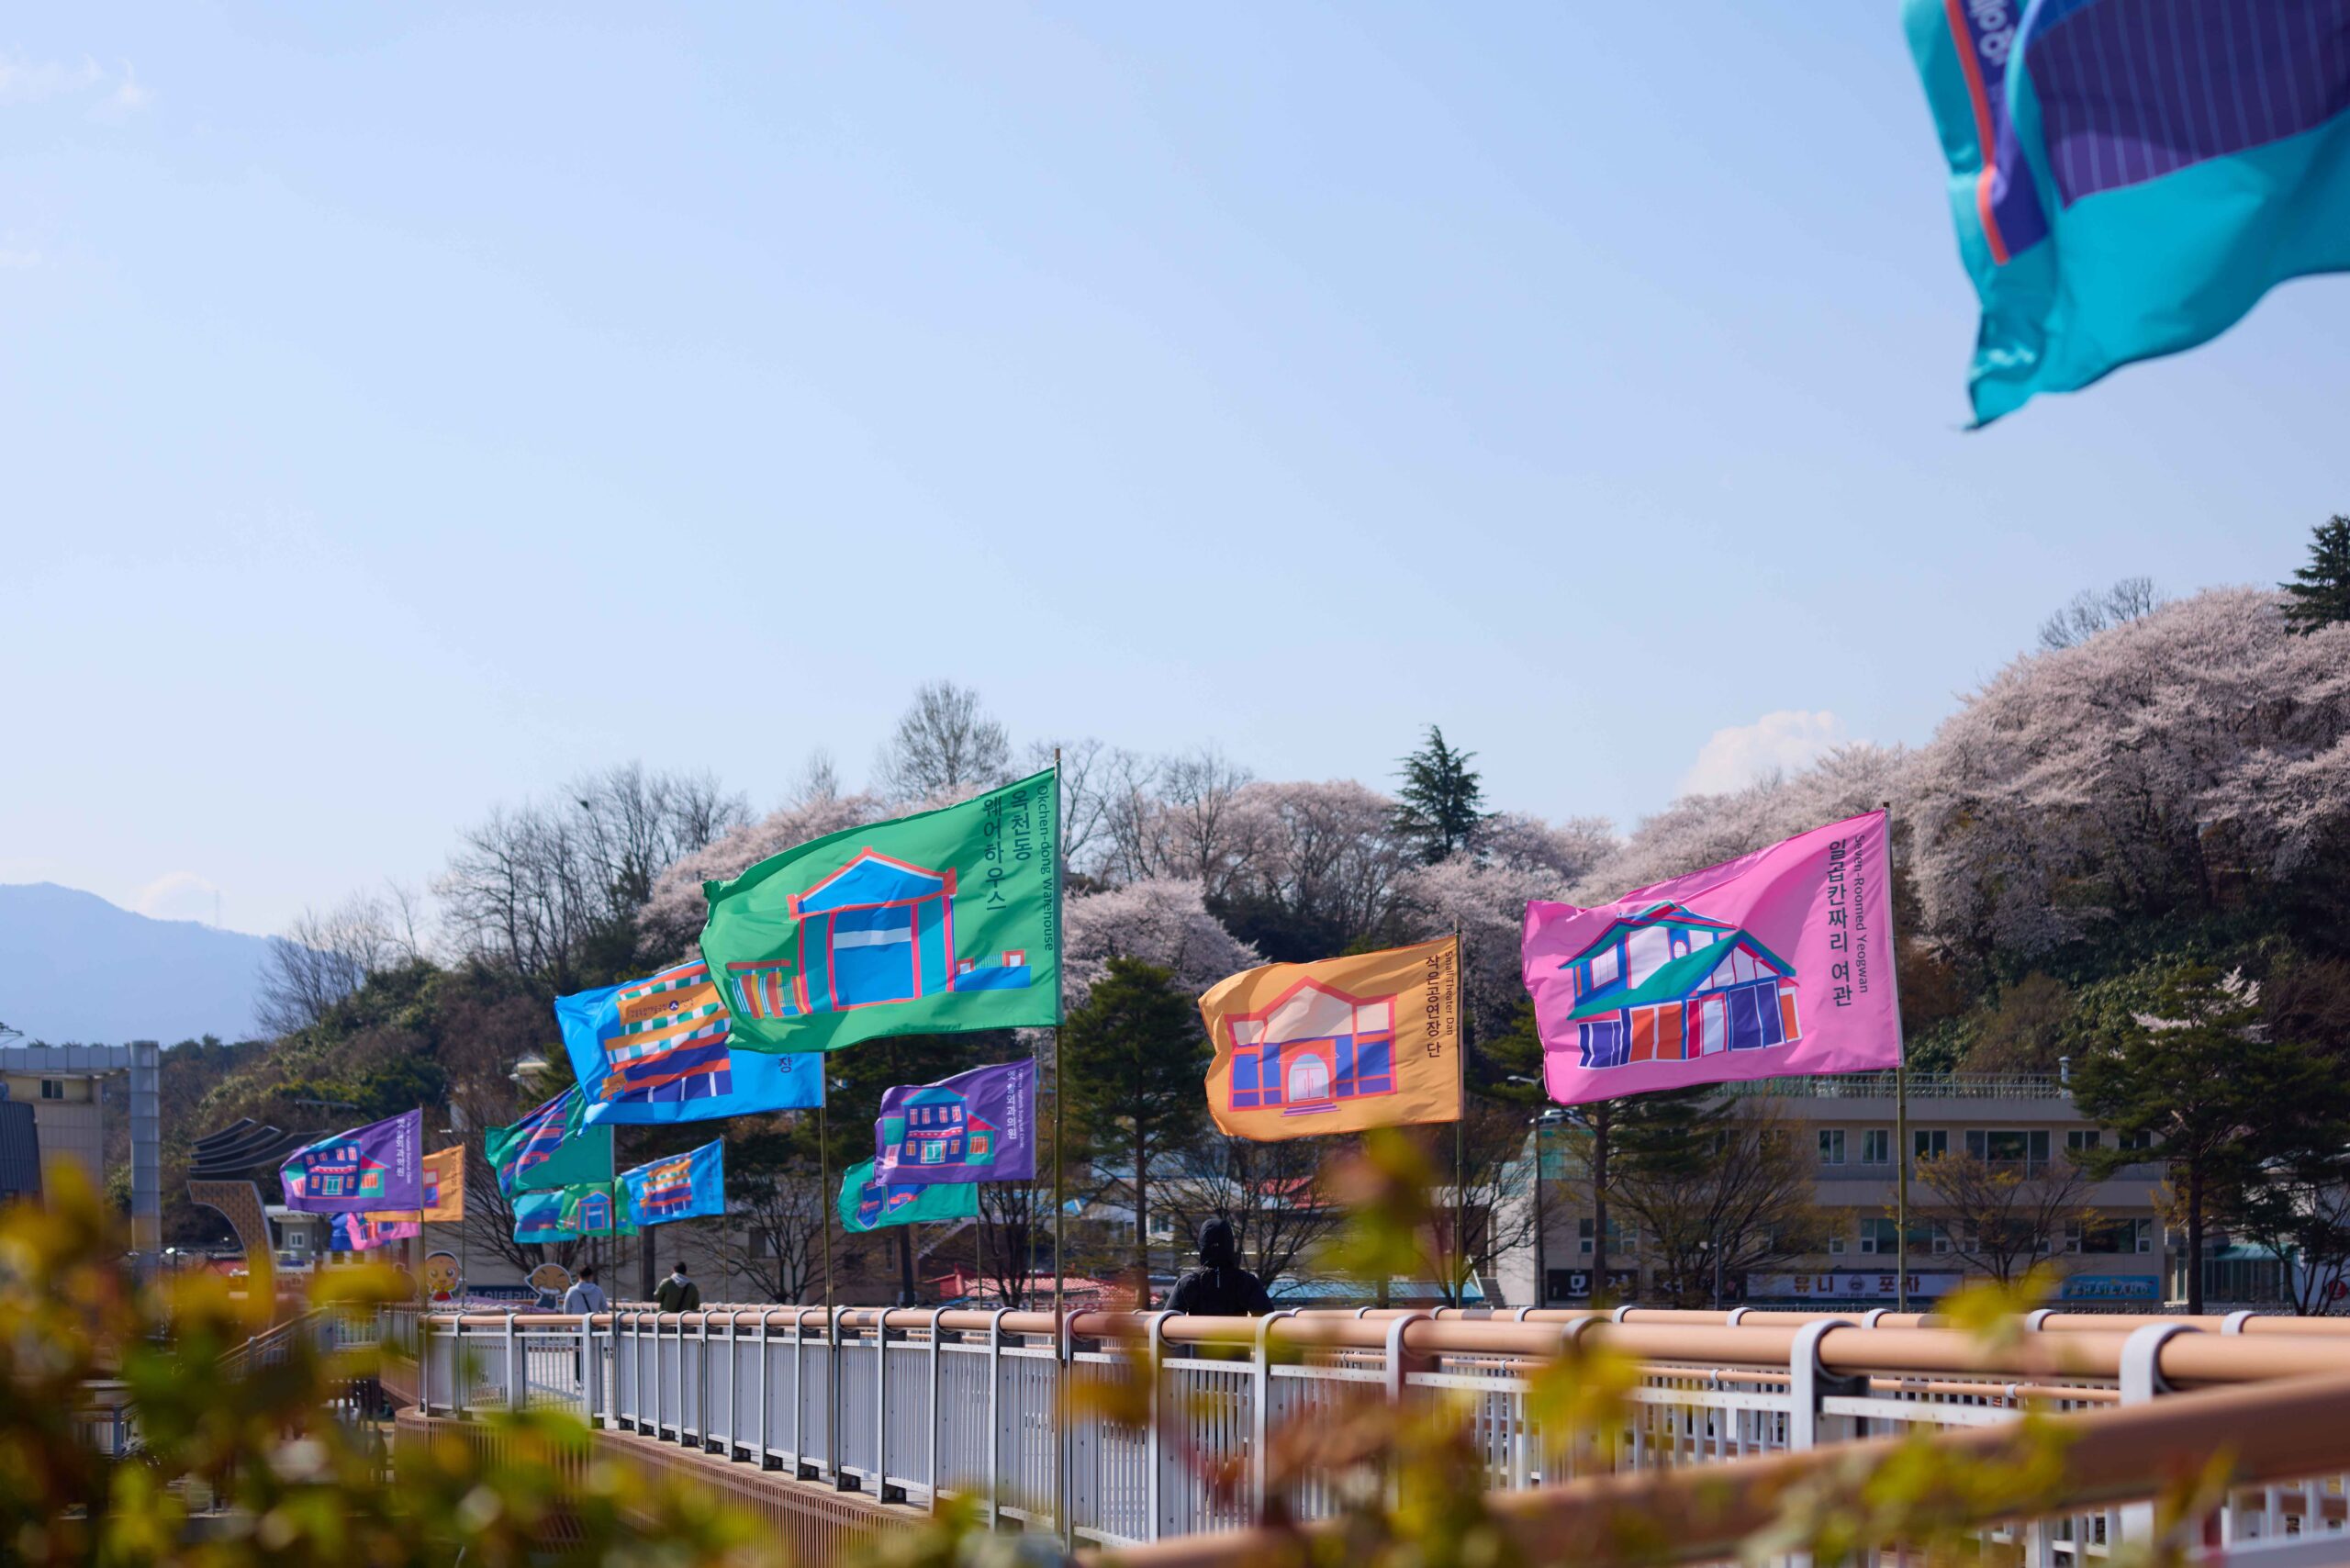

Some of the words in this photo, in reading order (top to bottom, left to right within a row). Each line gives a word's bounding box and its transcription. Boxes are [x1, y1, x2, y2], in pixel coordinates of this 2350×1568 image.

[983, 795, 1007, 911] 웨어하우스
[1011, 790, 1033, 861] 옥천동
[1037, 785, 1051, 875] Okchen-dong
[1043, 878, 1054, 951] Warehouse
[1827, 838, 1848, 953] 일곱칸짜리
[1853, 834, 1867, 931] Seven-Roomed
[1426, 954, 1441, 1037] 작은공연장
[1445, 950, 1455, 976] Small
[1445, 979, 1455, 1014] Theater
[1831, 960, 1853, 1007] 여관
[1855, 934, 1868, 993] Yeogwan
[1427, 1041, 1442, 1058] 단
[1446, 1017, 1455, 1036] Dan
